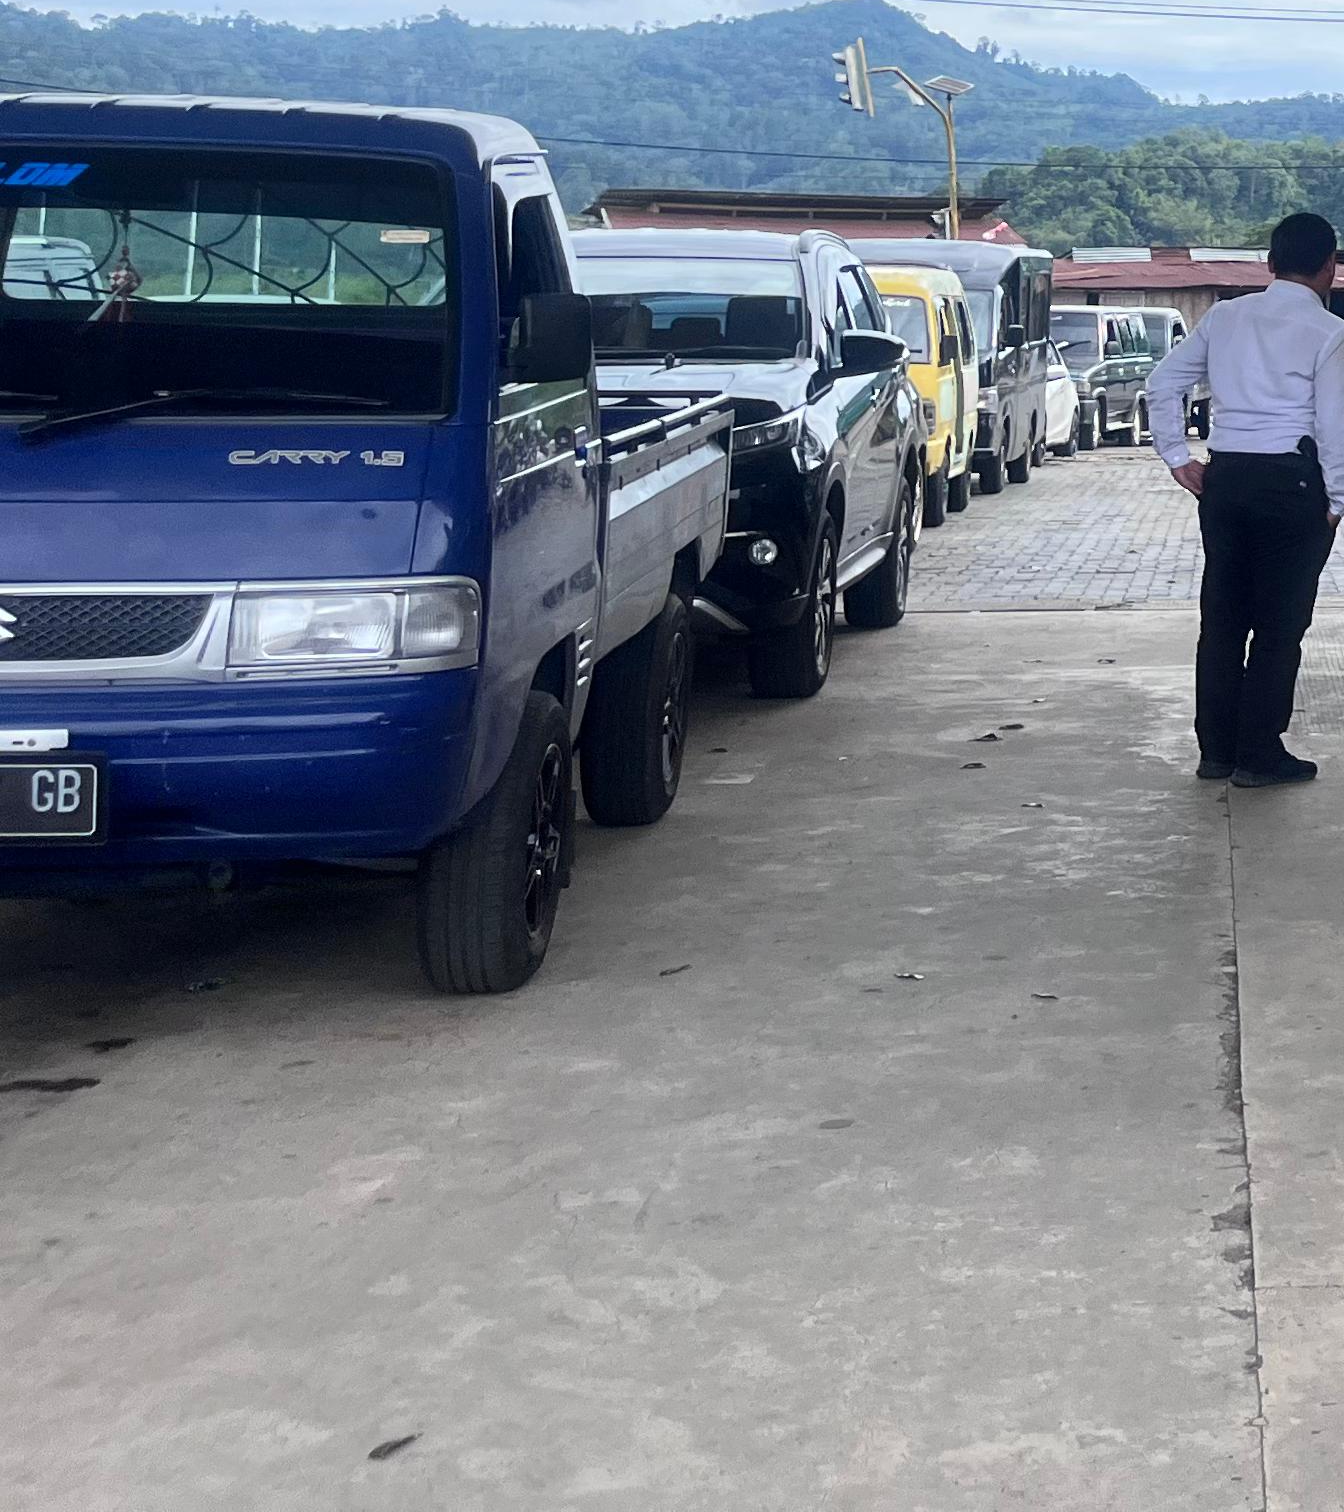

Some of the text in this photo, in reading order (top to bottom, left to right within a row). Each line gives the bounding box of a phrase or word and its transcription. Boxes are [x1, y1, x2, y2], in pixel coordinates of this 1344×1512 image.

[228, 449, 405, 467] CARRY 1.5
[31, 769, 81, 813] GB
